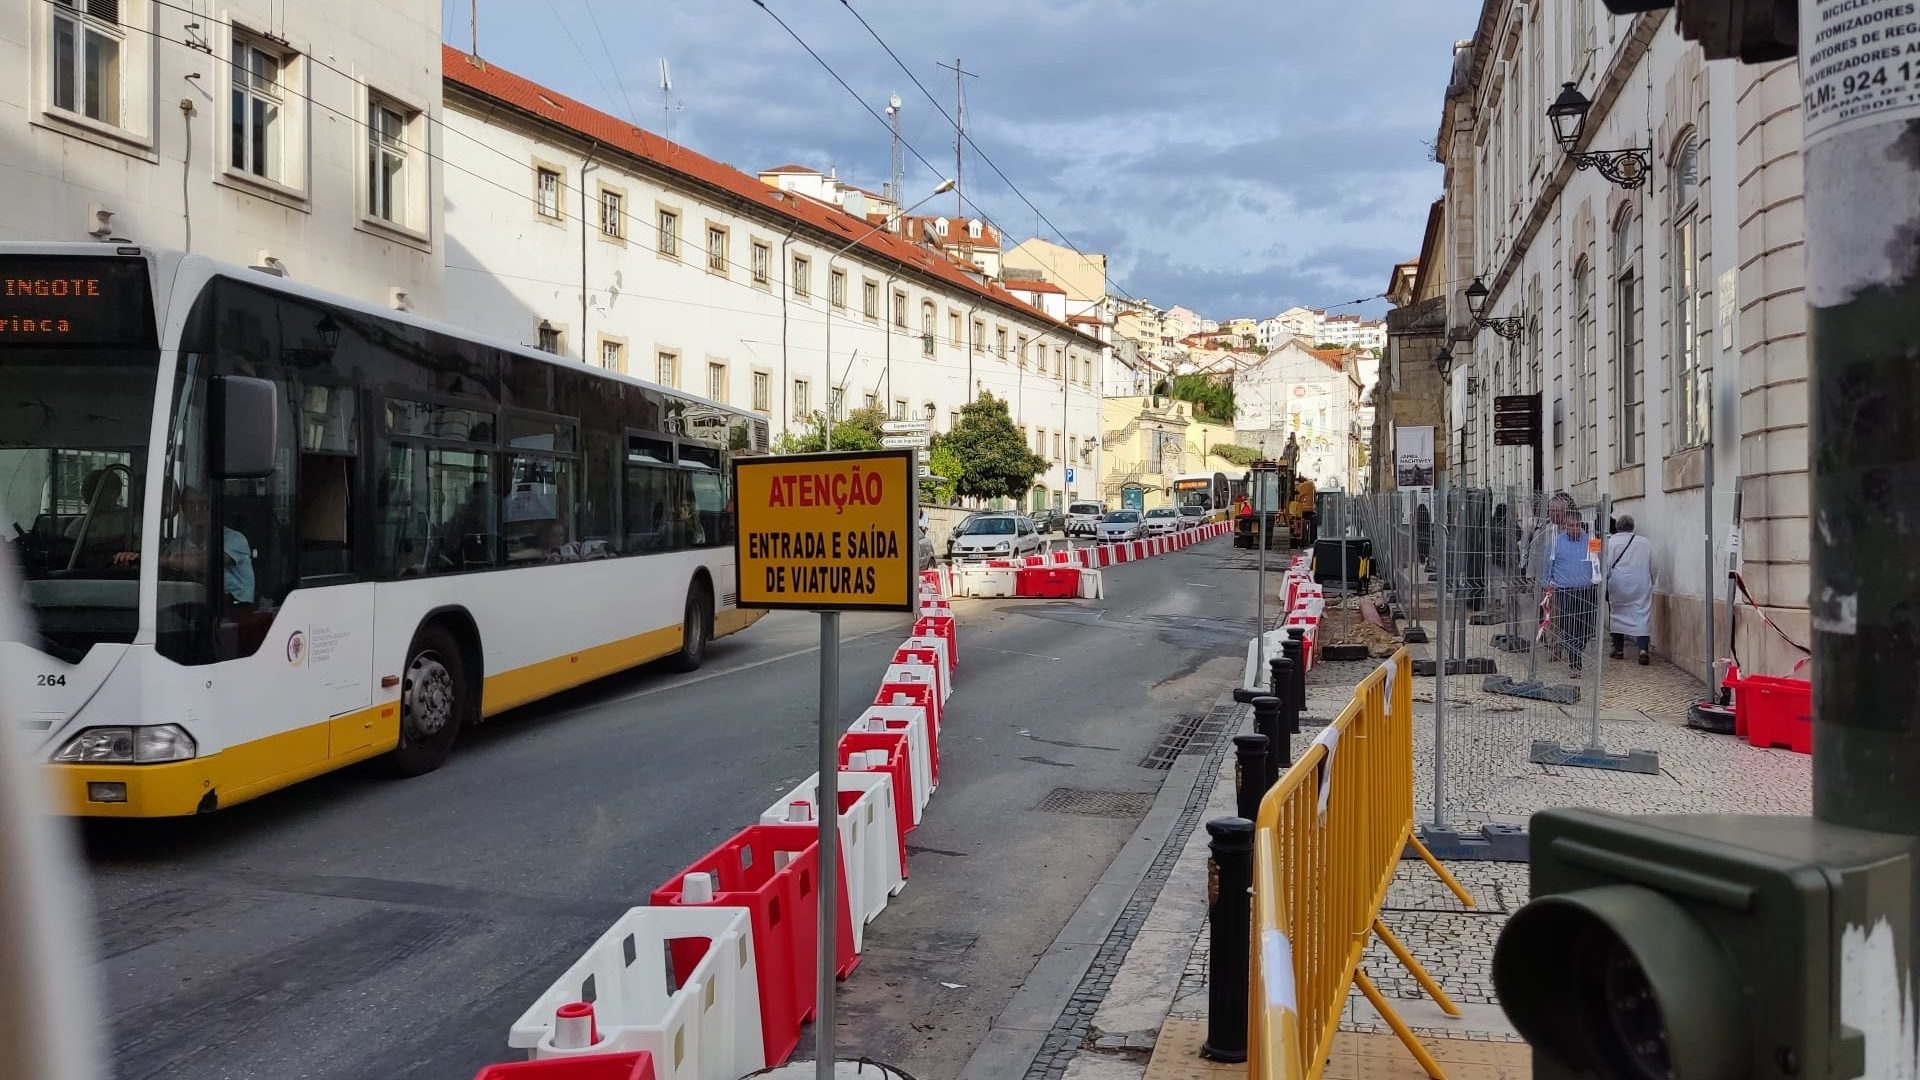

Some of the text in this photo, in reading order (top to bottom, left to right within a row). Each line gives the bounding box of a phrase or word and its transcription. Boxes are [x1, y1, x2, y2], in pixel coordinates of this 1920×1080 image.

[1815, 4, 1914, 45] ATOMIZADORES
[1810, 23, 1920, 66] MOTORES DE REG
[1804, 84, 1836, 115] TLM:
[1842, 66, 1887, 95] 924
[1840, 97, 1898, 119] DESDE
[5, 279, 100, 296] INGOTE
[769, 464, 883, 515] ATENÇÃO
[749, 524, 898, 559] ENTRADA E SAÍDA
[766, 566, 876, 594] DE VIATURAS
[37, 674, 66, 686] 264
